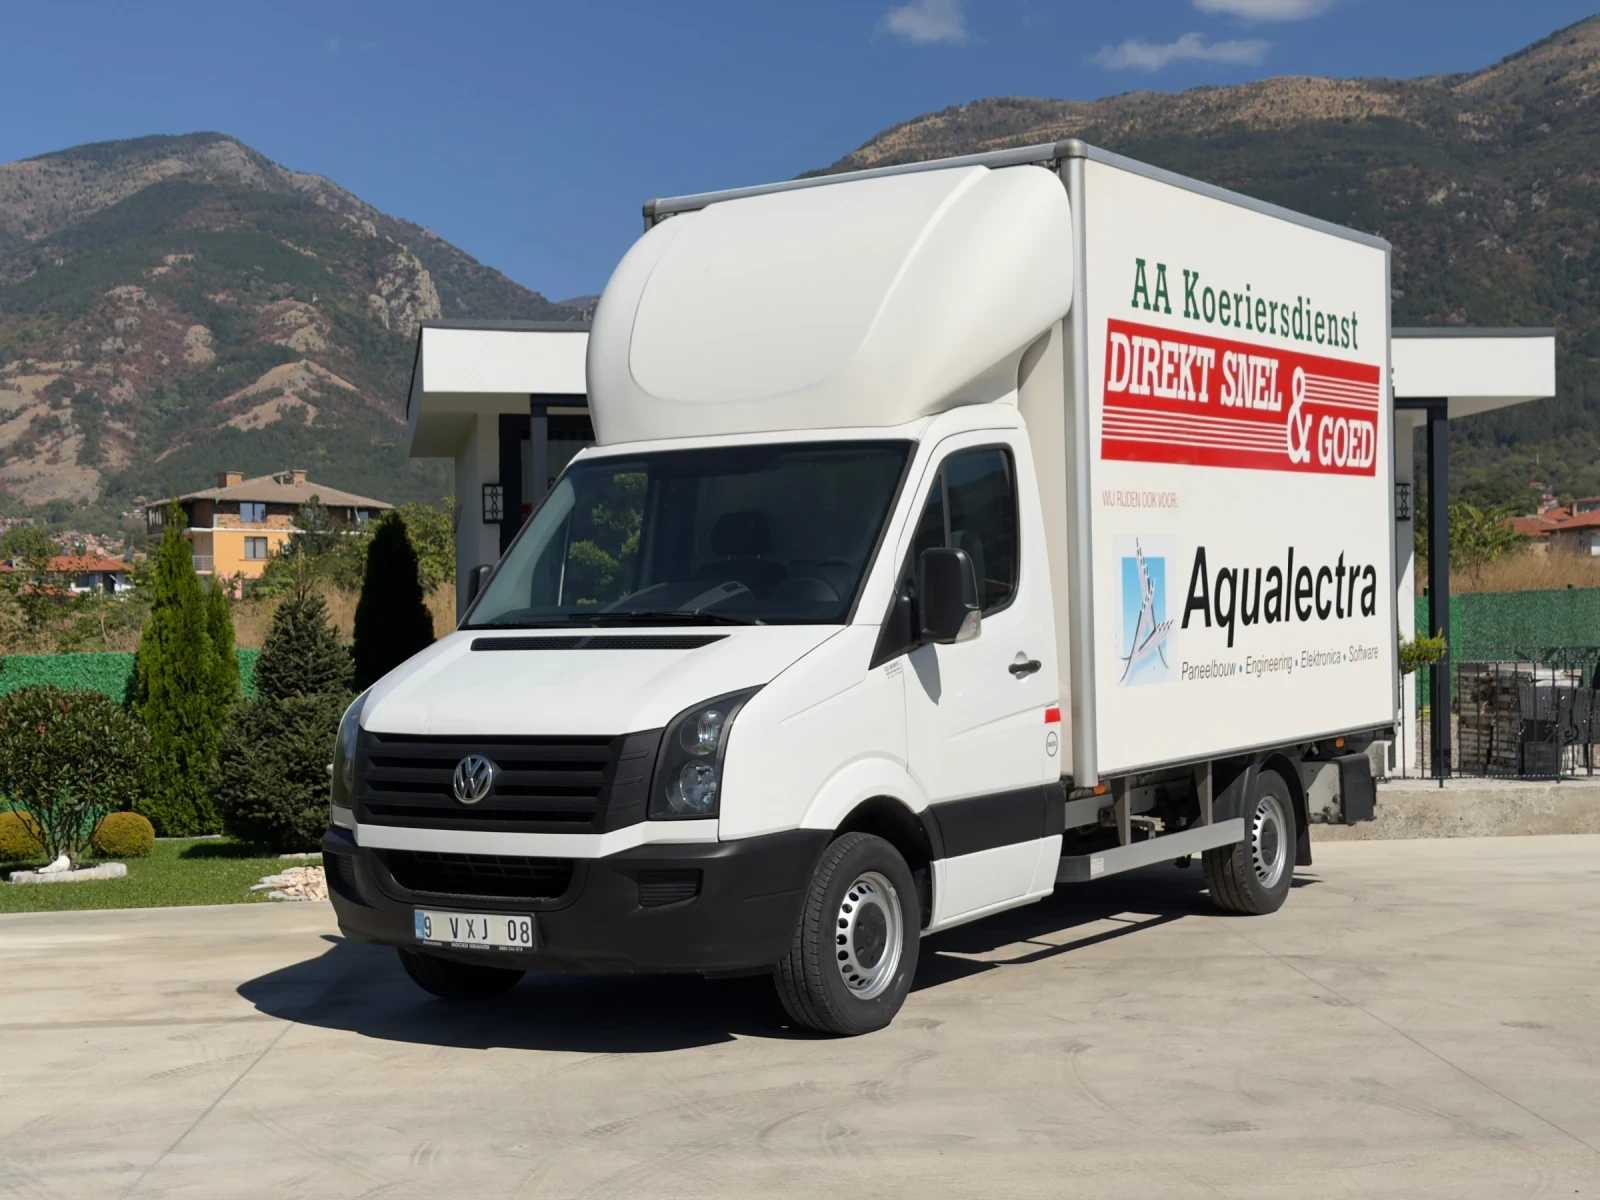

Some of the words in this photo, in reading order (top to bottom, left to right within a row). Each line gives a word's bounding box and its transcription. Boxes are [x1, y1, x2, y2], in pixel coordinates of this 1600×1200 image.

[1131, 258, 1172, 314] AA
[1183, 269, 1358, 350] Koeriersdienst
[1107, 331, 1216, 403] DIREKT
[1220, 350, 1283, 412] SNEL
[1287, 366, 1313, 464] &
[1317, 415, 1375, 468] GOED
[1142, 491, 1157, 508] OOK
[1181, 546, 1377, 648] Aqualectra
[1181, 660, 1236, 681] Paneelbouw
[1245, 654, 1293, 678] Engineering
[1300, 649, 1341, 668] Elektronica
[1348, 644, 1379, 663] Software
[424, 915, 432, 938] 9
[449, 917, 488, 940] VXJ
[507, 919, 530, 944] 08
